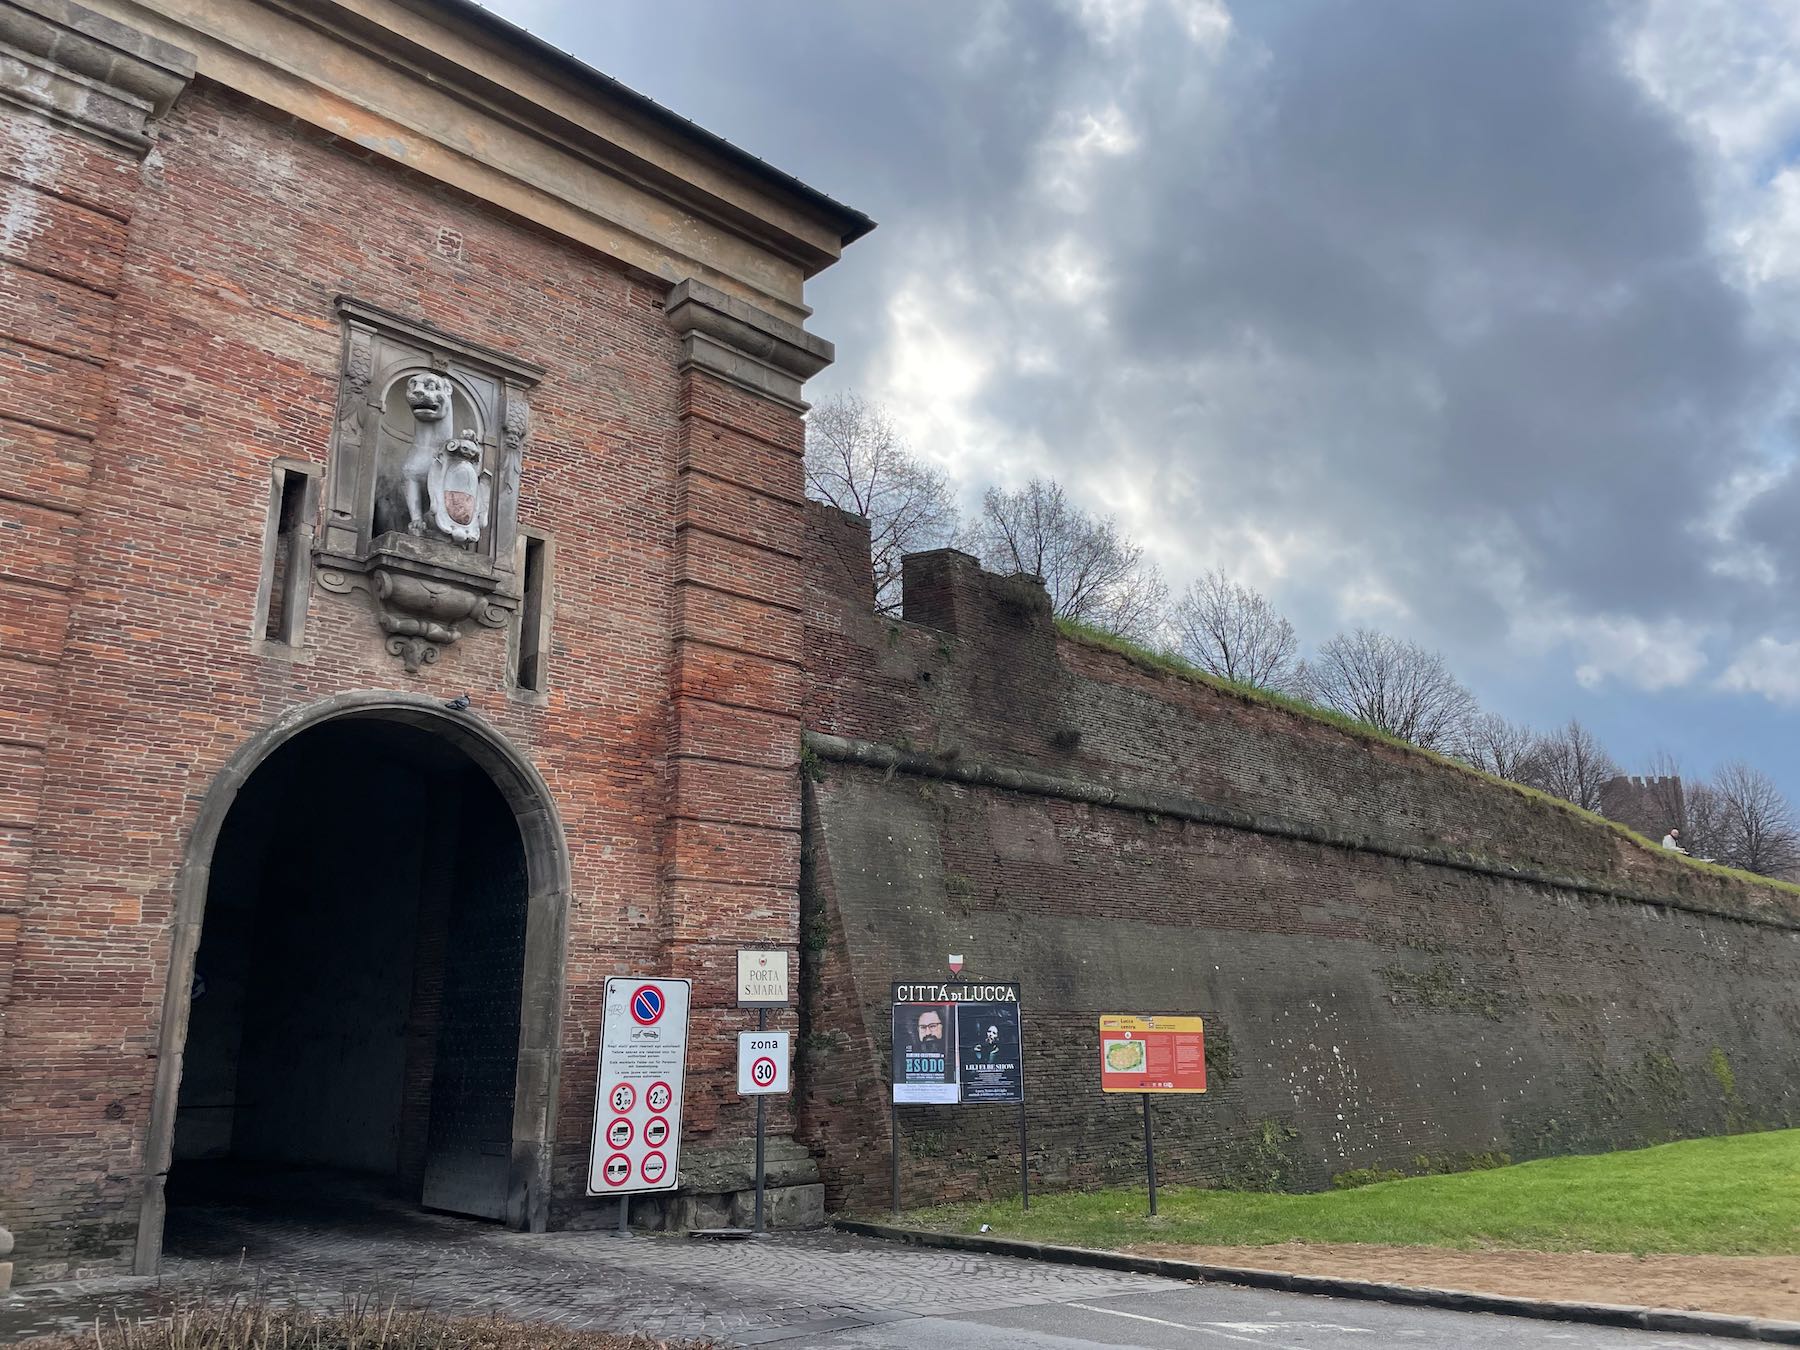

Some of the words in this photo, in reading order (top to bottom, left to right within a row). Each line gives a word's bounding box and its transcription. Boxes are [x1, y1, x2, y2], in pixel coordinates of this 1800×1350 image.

[749, 969, 779, 981] PORTA
[744, 984, 784, 996] S.MARIA
[951, 992, 962, 1001] DI
[963, 985, 1017, 1002] LUCCA
[750, 1040, 779, 1050] zona
[756, 1064, 772, 1080] 30
[905, 1058, 945, 1073] ESODO
